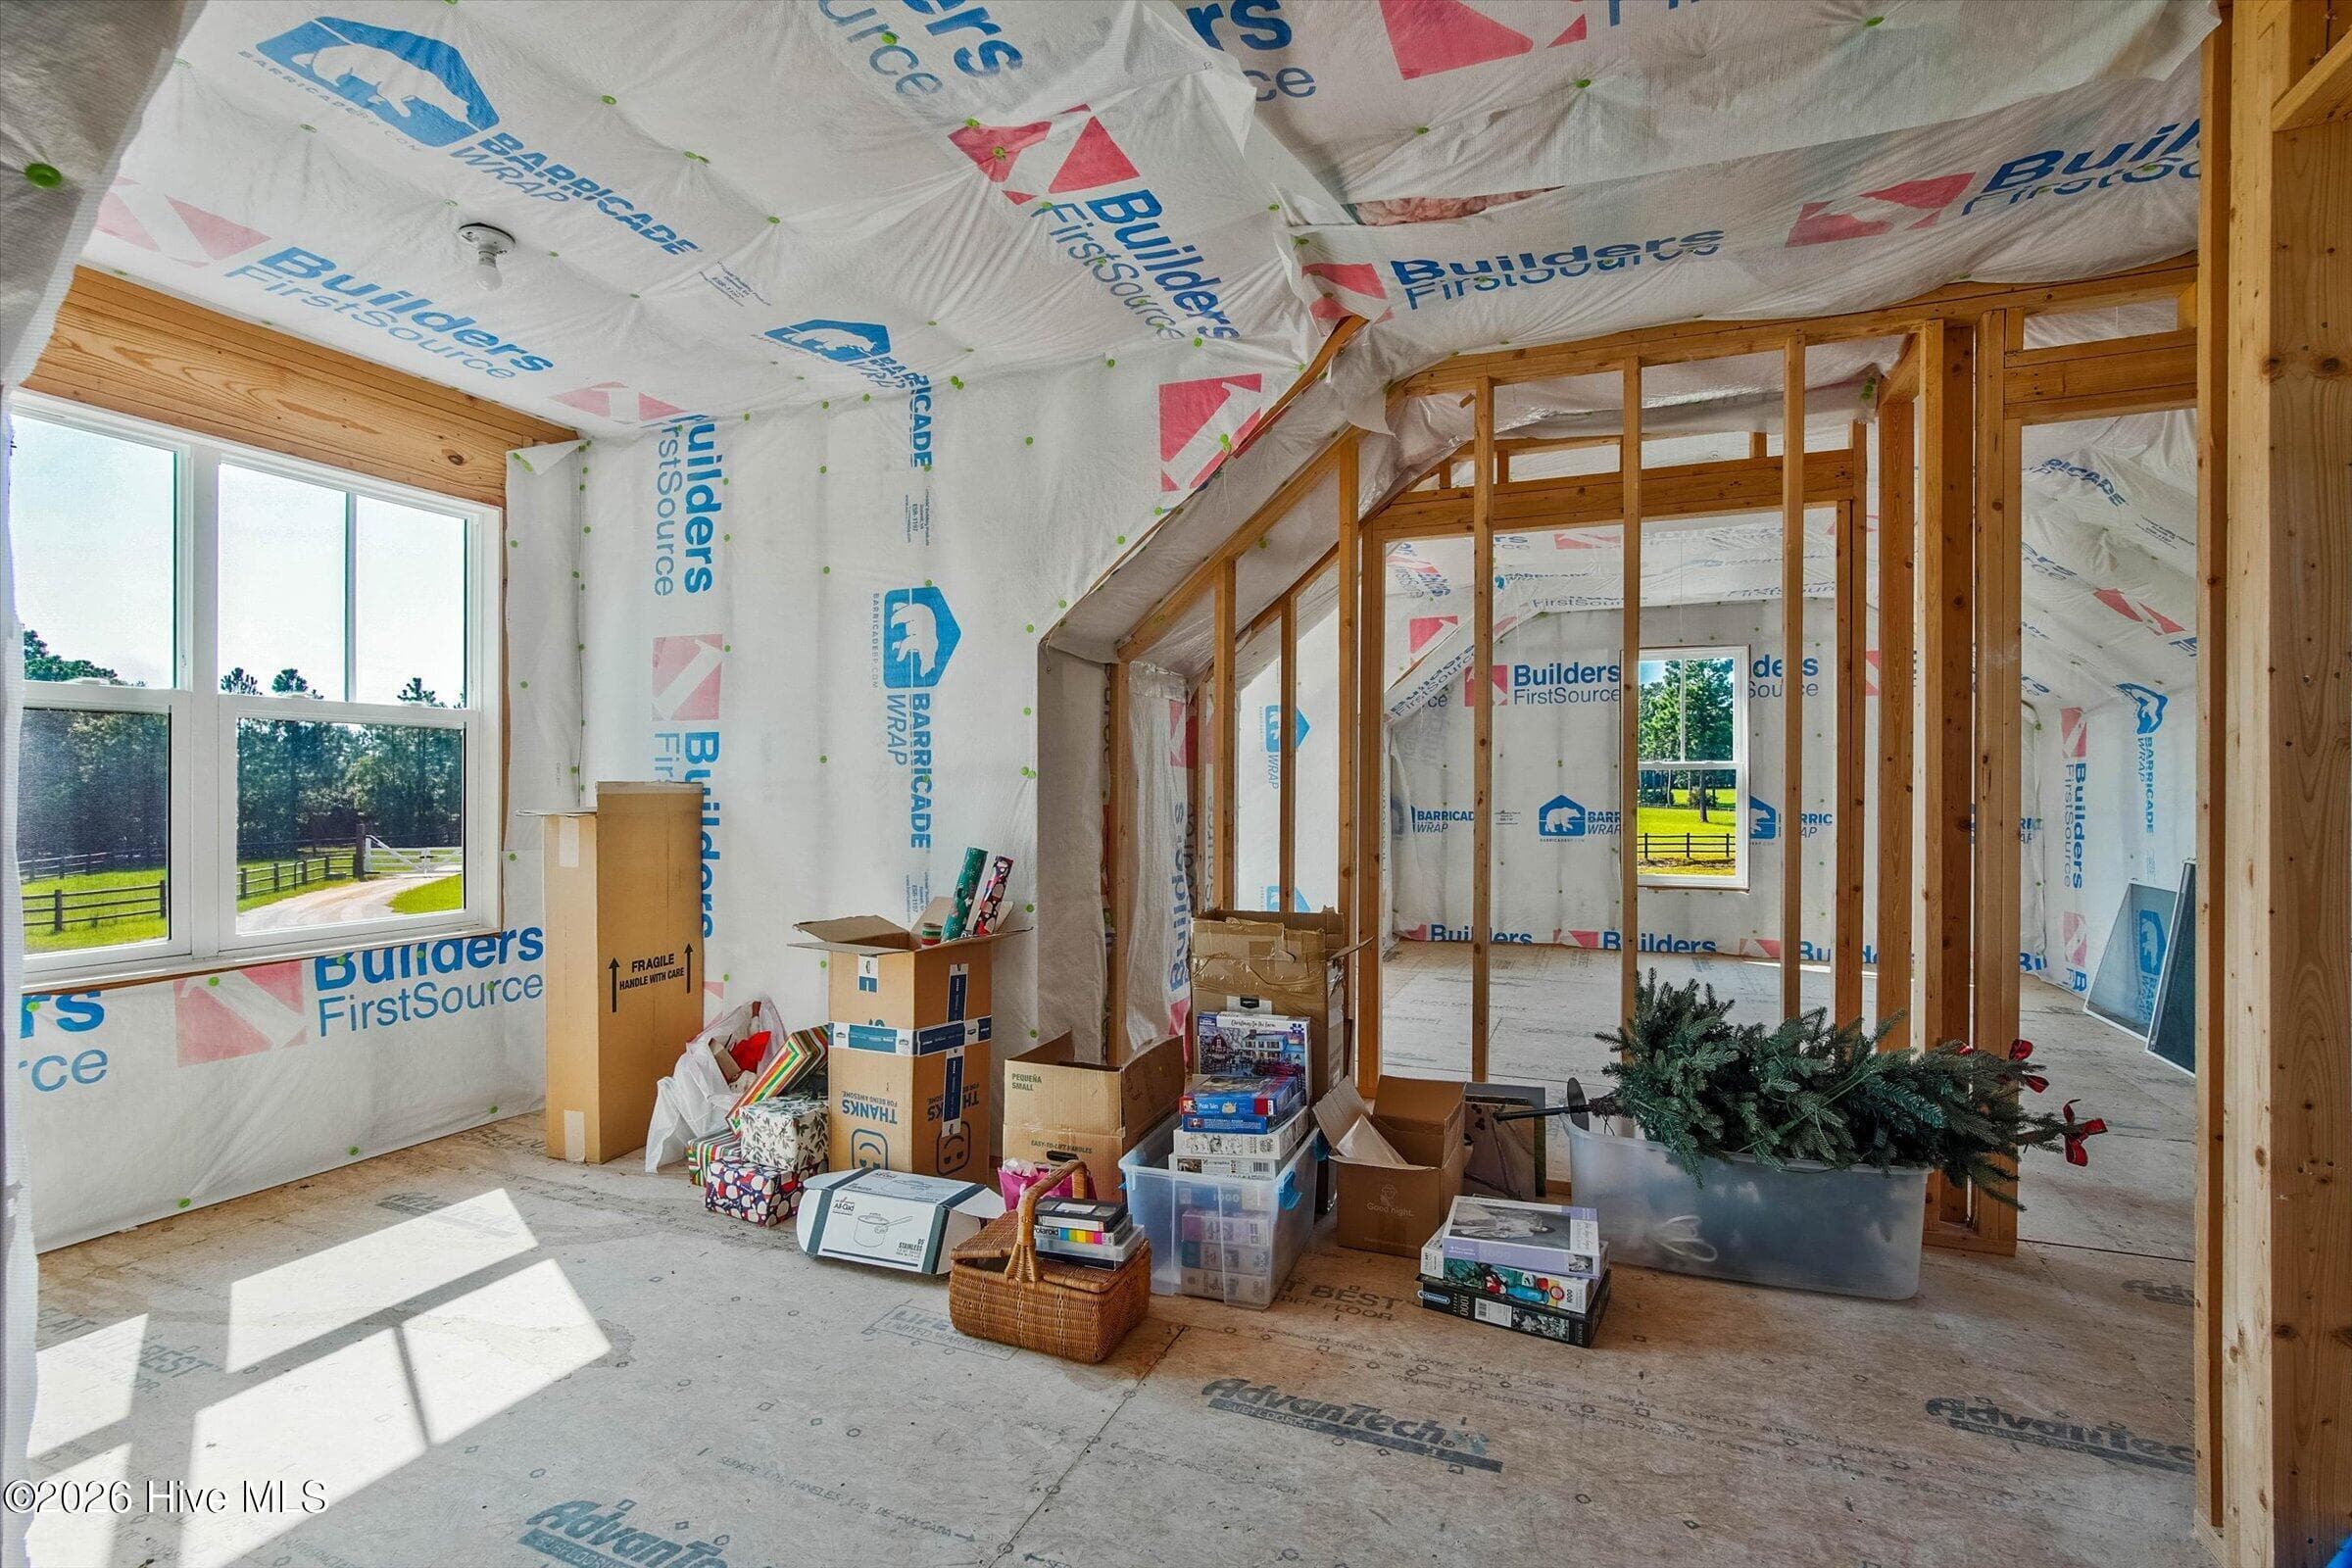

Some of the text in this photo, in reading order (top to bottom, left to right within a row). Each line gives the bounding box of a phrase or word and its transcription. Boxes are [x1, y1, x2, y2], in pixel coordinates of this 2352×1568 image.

[449, 145, 570, 204] WRAP
[1981, 118, 2201, 195] Buil
[475, 131, 703, 257] BARRICADE
[1030, 202, 1186, 340] FirstSource
[1085, 188, 1241, 339] Builders
[1390, 229, 1725, 286] Builders
[223, 265, 517, 380] FirstSource
[257, 246, 555, 373] Builders
[669, 413, 723, 595] uilders
[1514, 662, 1621, 687] Builders
[1752, 654, 1819, 678] des
[1514, 687, 1621, 706] FirstSource
[885, 693, 908, 766] WRAP
[909, 693, 932, 850] BARRICADE
[1267, 754, 1280, 790] WRAP
[1415, 822, 1448, 833] WRAP
[2064, 763, 2075, 889] FirstSource
[2073, 762, 2087, 890] Builders
[1603, 929, 1717, 954] Bilders
[619, 966, 685, 991] HANDLE WITH CARE
[631, 953, 675, 974] FRAGILE
[318, 971, 545, 1039] FirstSource
[18, 1049, 109, 1093] ce
[1011, 1082, 1035, 1092] SMALL
[841, 1099, 899, 1125] THANKS
[927, 1091, 980, 1122] THKS
[1366, 1201, 1390, 1214] Good
[898, 1242, 924, 1251] STAINLESS
[1310, 1284, 1404, 1310] BEST
[1324, 1301, 1394, 1321] FLOOR
[1459, 1295, 1469, 1316] 1000
